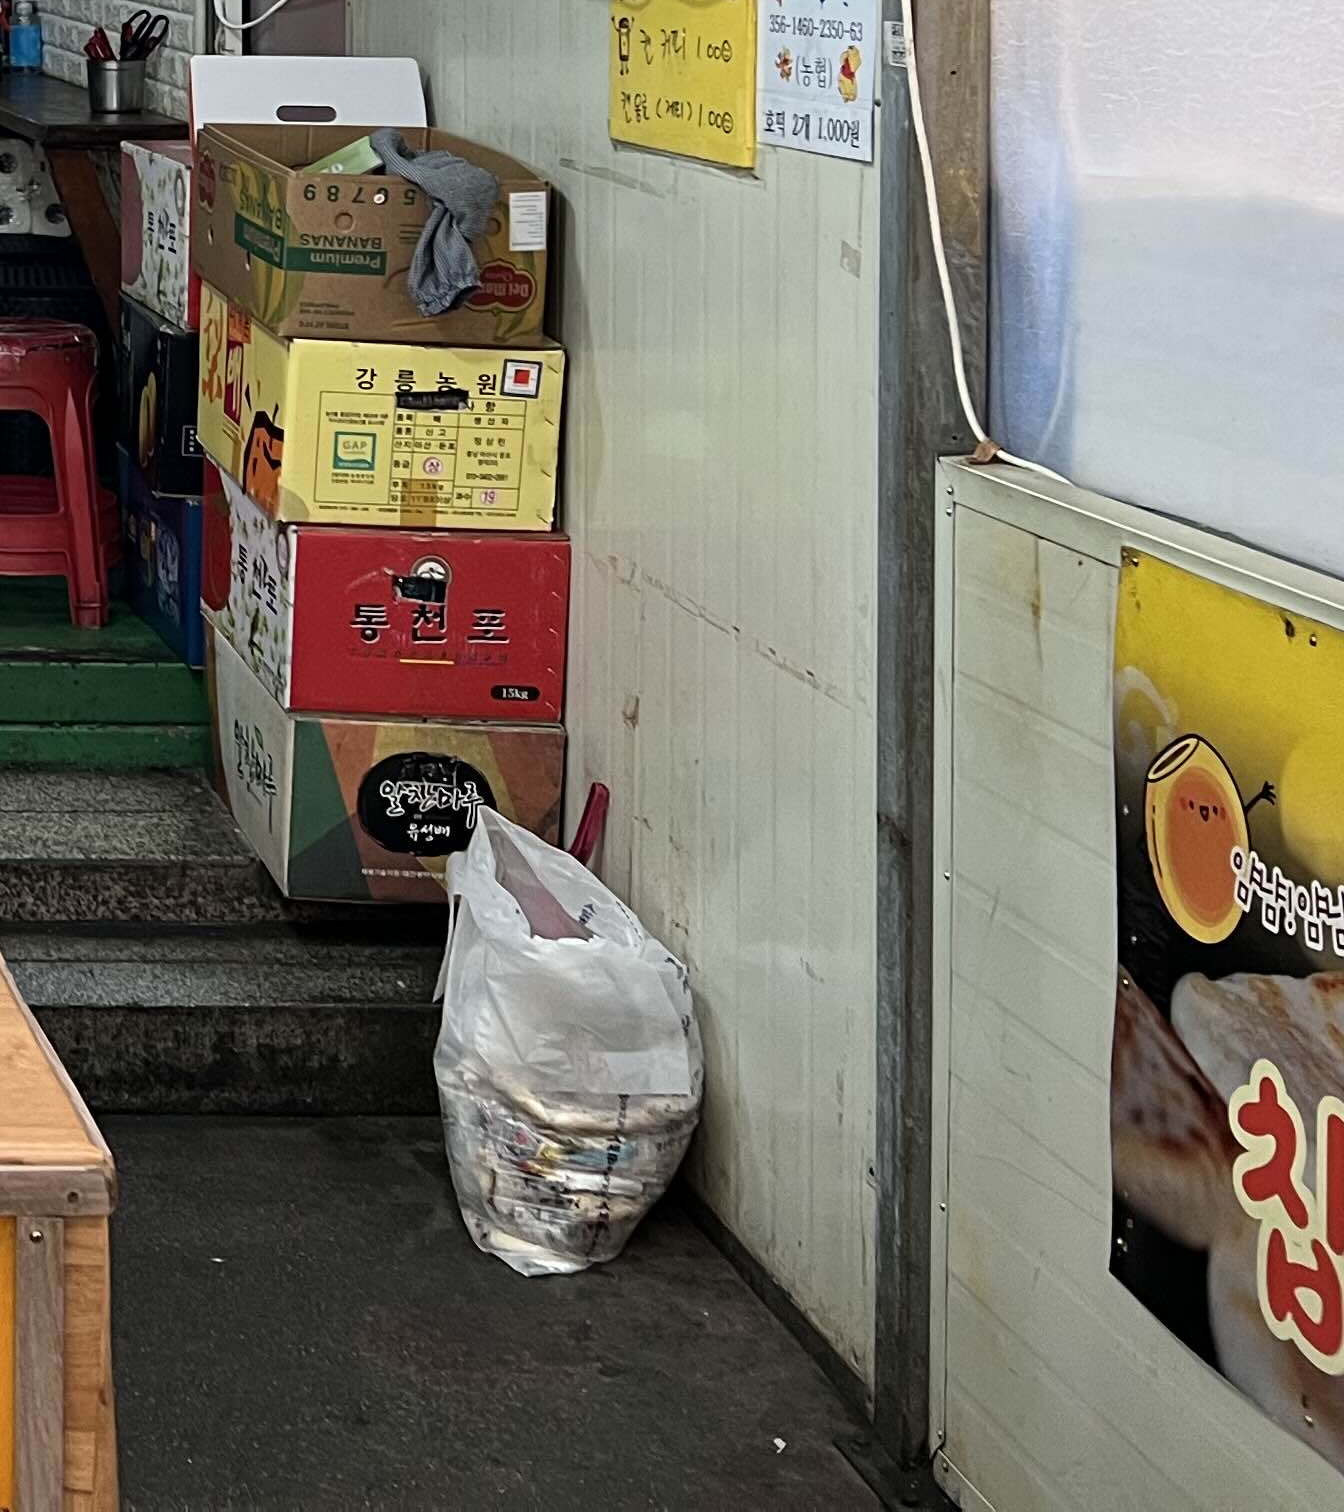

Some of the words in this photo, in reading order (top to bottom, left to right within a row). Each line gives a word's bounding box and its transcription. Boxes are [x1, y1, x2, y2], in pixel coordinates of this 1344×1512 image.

[769, 14, 863, 41] 356-1460-2350-63
[792, 114, 810, 141] 2개
[304, 183, 316, 201] 9
[327, 184, 339, 201] 8
[353, 186, 364, 203] 7
[300, 233, 383, 249] BANANAS
[310, 251, 381, 267] Premium
[342, 441, 367, 451] GAP
[500, 687, 529, 700] 15kg
